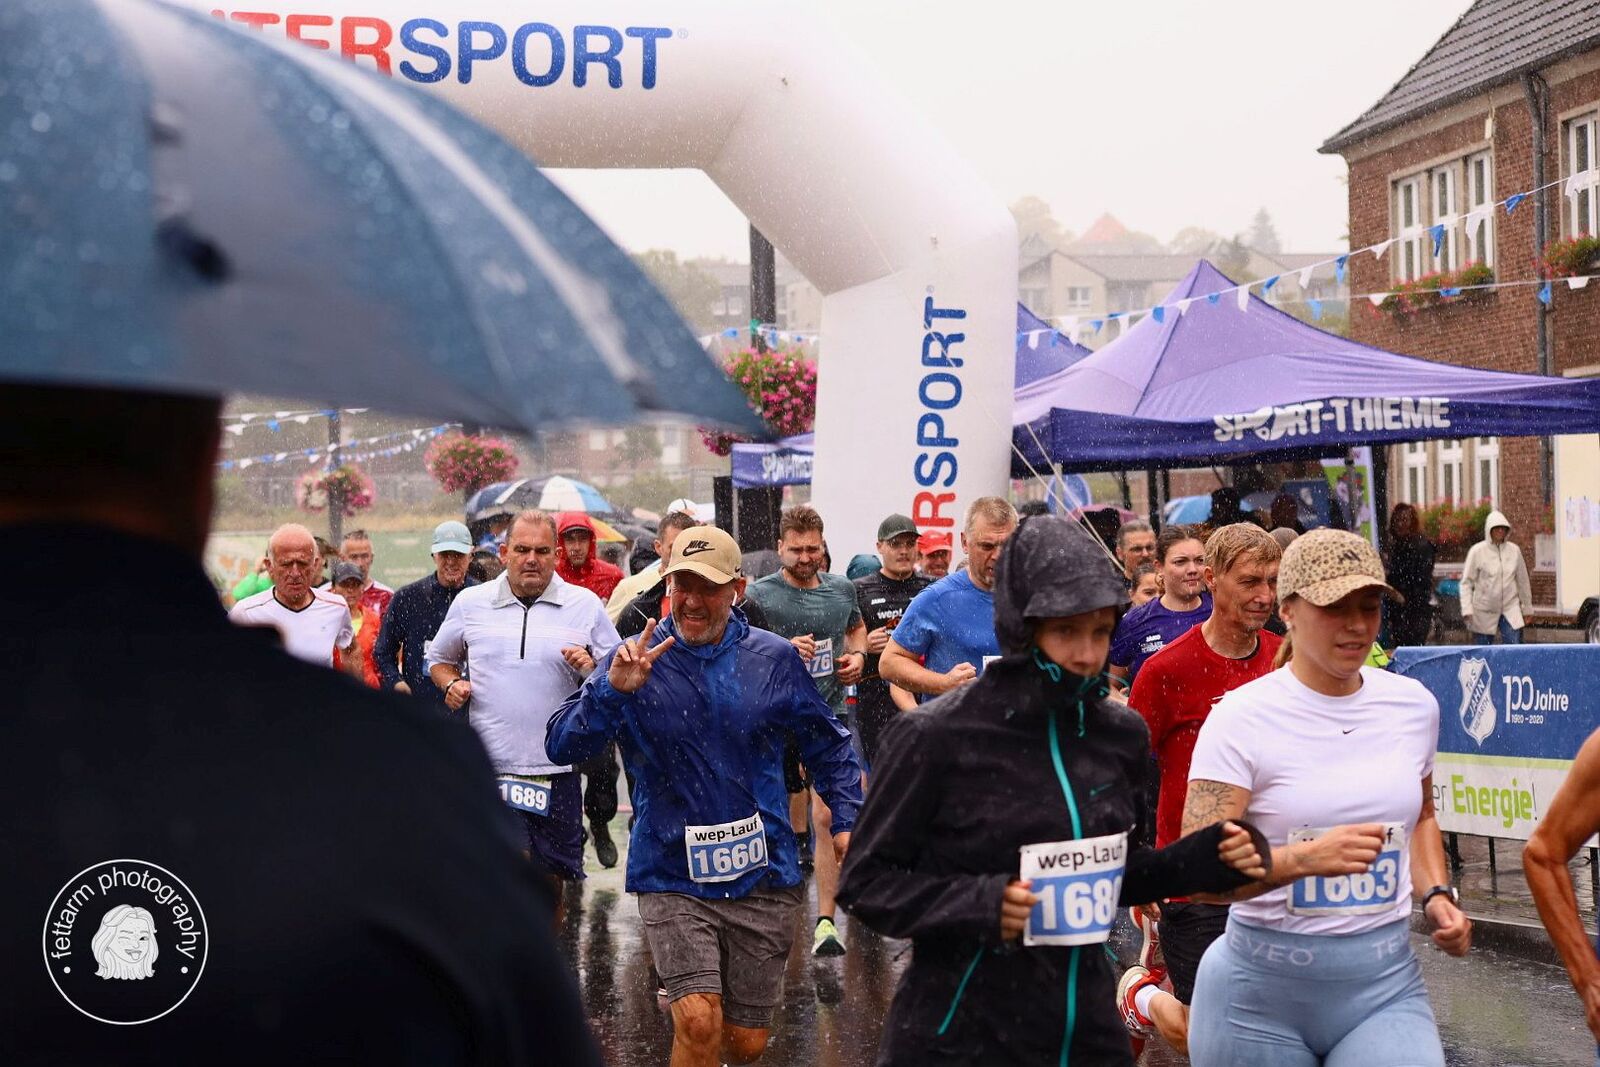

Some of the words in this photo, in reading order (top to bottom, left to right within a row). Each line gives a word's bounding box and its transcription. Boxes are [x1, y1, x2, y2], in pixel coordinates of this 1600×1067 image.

[211, 9, 673, 90] TERSPORT
[911, 296, 967, 563] RSPORT
[1213, 397, 1451, 441] SPORT-THIEME
[686, 540, 709, 549] NIKE
[1470, 679, 1485, 717] JAHN
[1534, 688, 1569, 712] Jahre
[1529, 714, 1544, 724] 2020
[498, 782, 547, 811] 1689
[1432, 784, 1446, 811] er
[1451, 774, 1538, 828] Energie!
[694, 817, 759, 842] wep-Lauf
[694, 837, 763, 874] 1660
[1304, 858, 1397, 903] 1663
